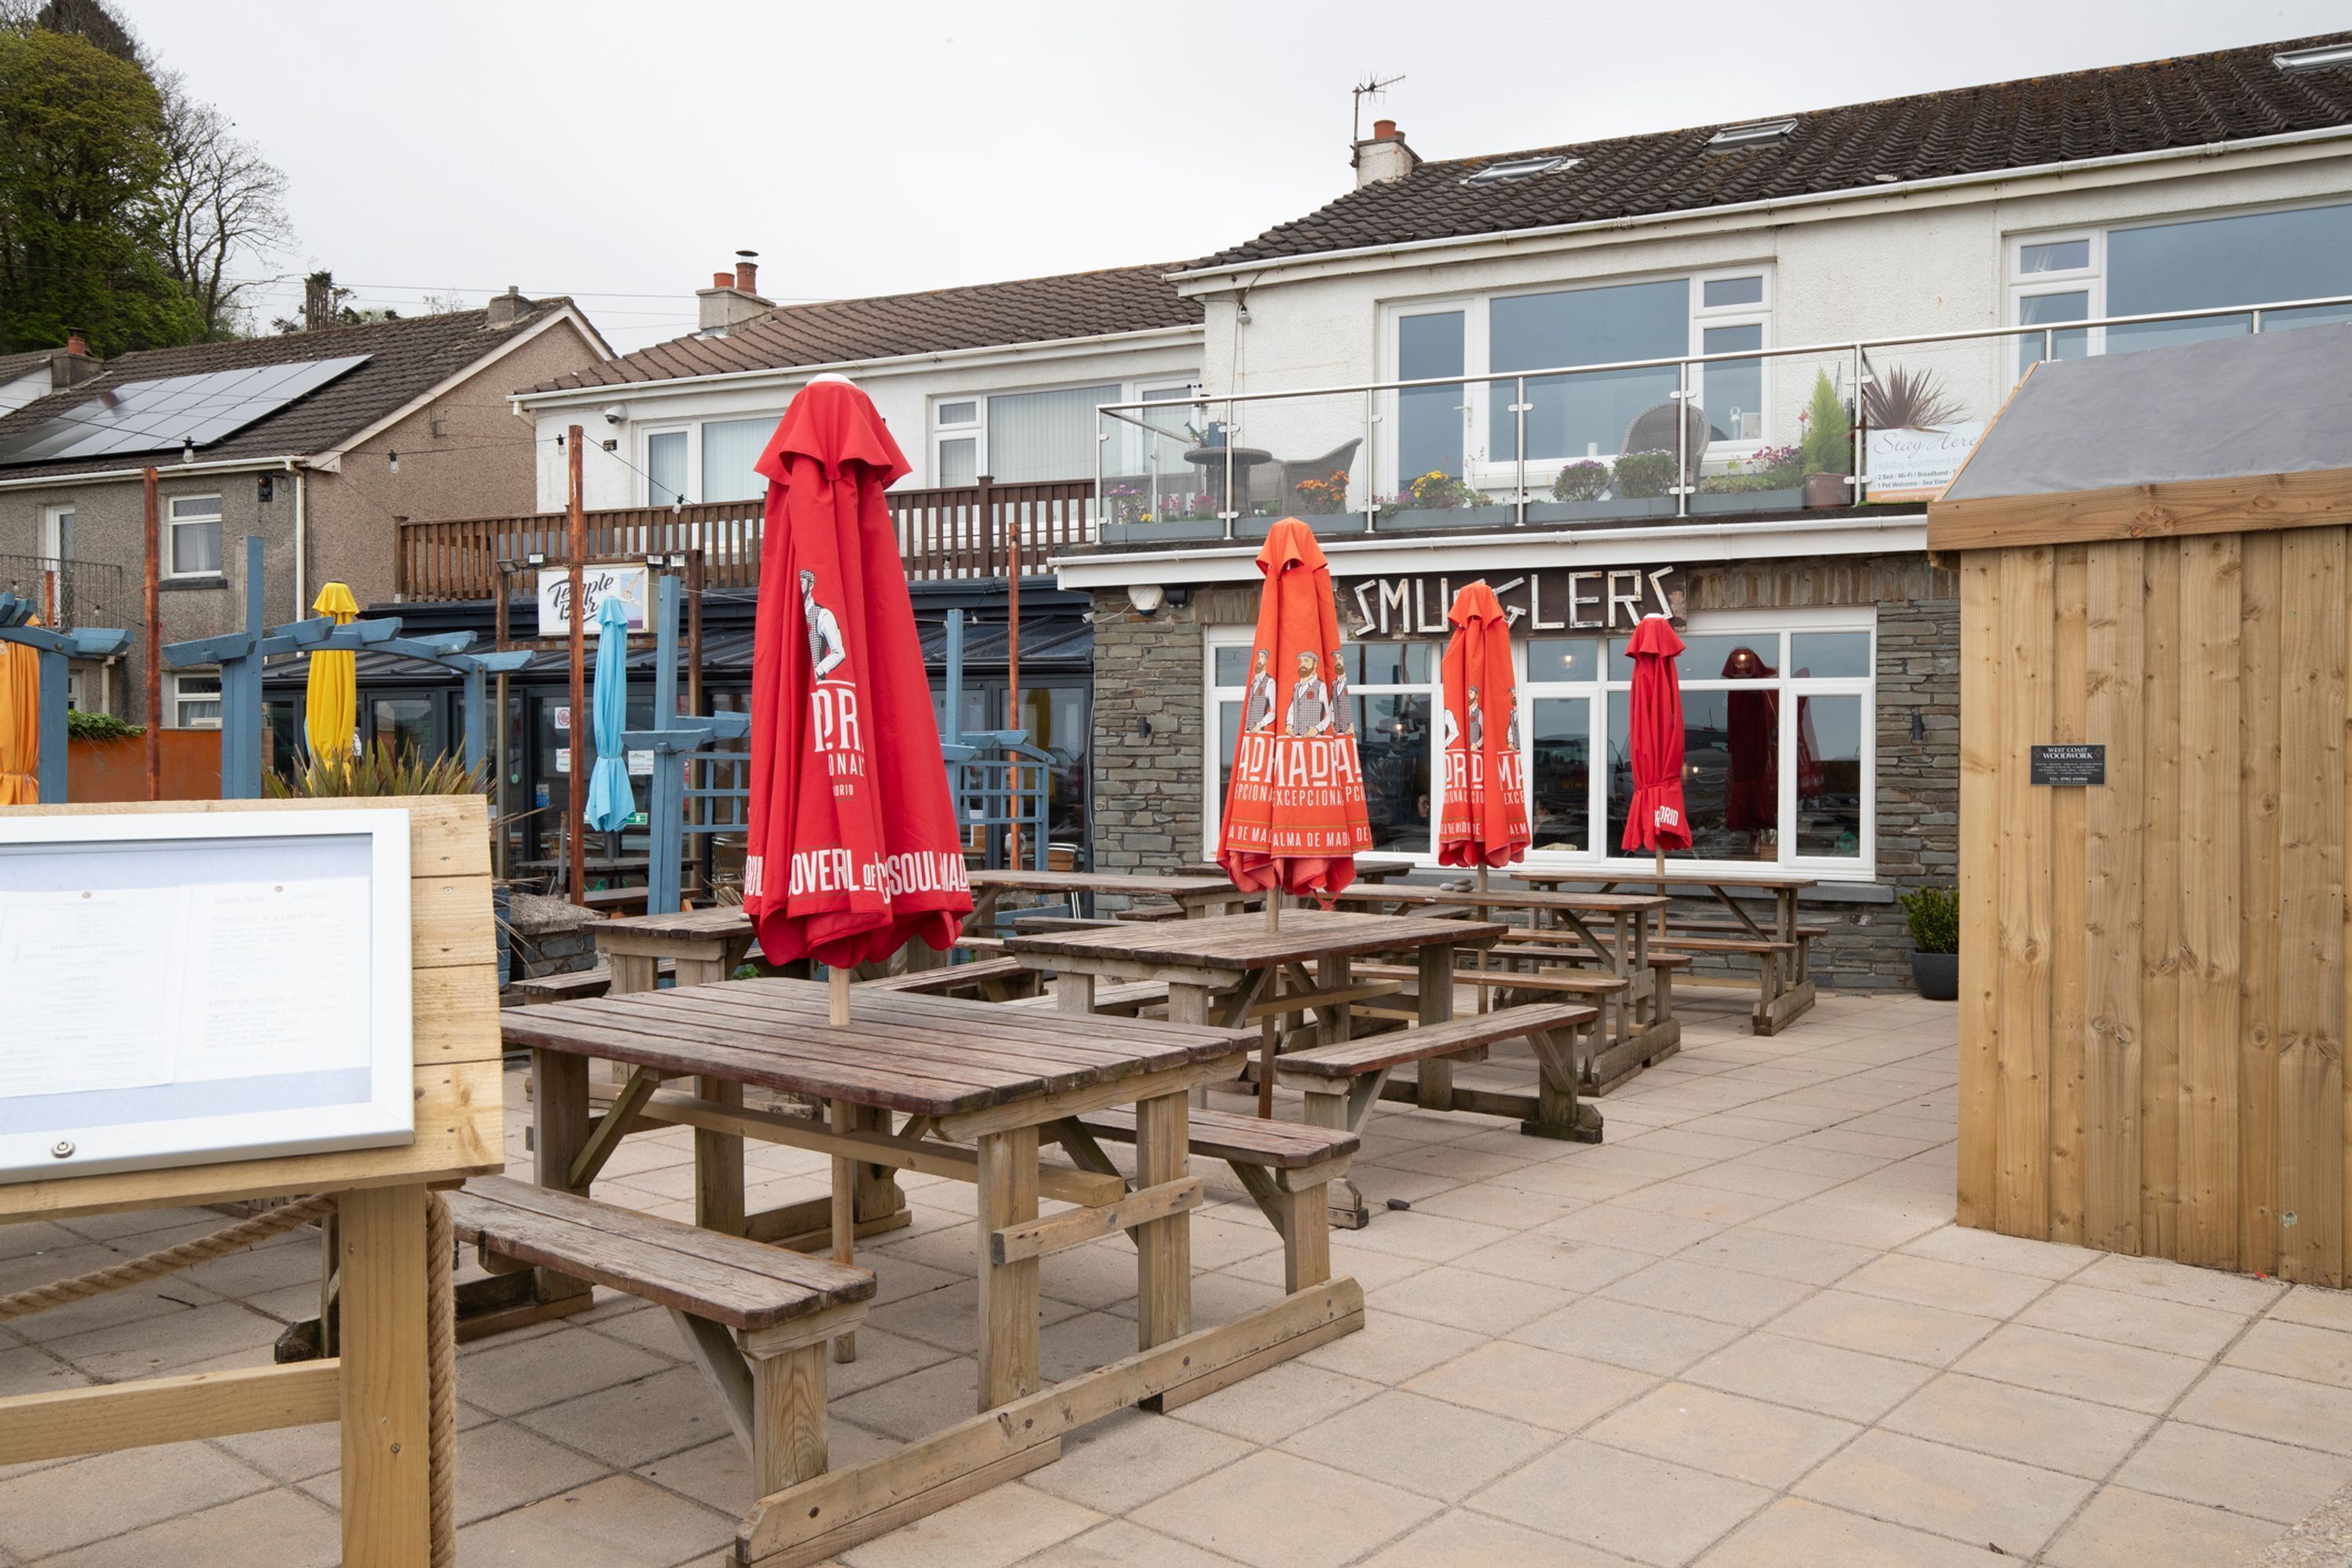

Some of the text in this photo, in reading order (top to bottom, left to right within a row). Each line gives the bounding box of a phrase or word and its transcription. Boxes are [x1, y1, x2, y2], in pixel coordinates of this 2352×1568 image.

[1874, 427, 1977, 459] Stay Here
[1875, 459, 1905, 471] Holiday
[1907, 458, 1951, 470] Apartment
[547, 572, 614, 606] Teple
[559, 596, 600, 621] Br
[1272, 832, 1301, 848] ALMA
[1307, 832, 1320, 848] DE
